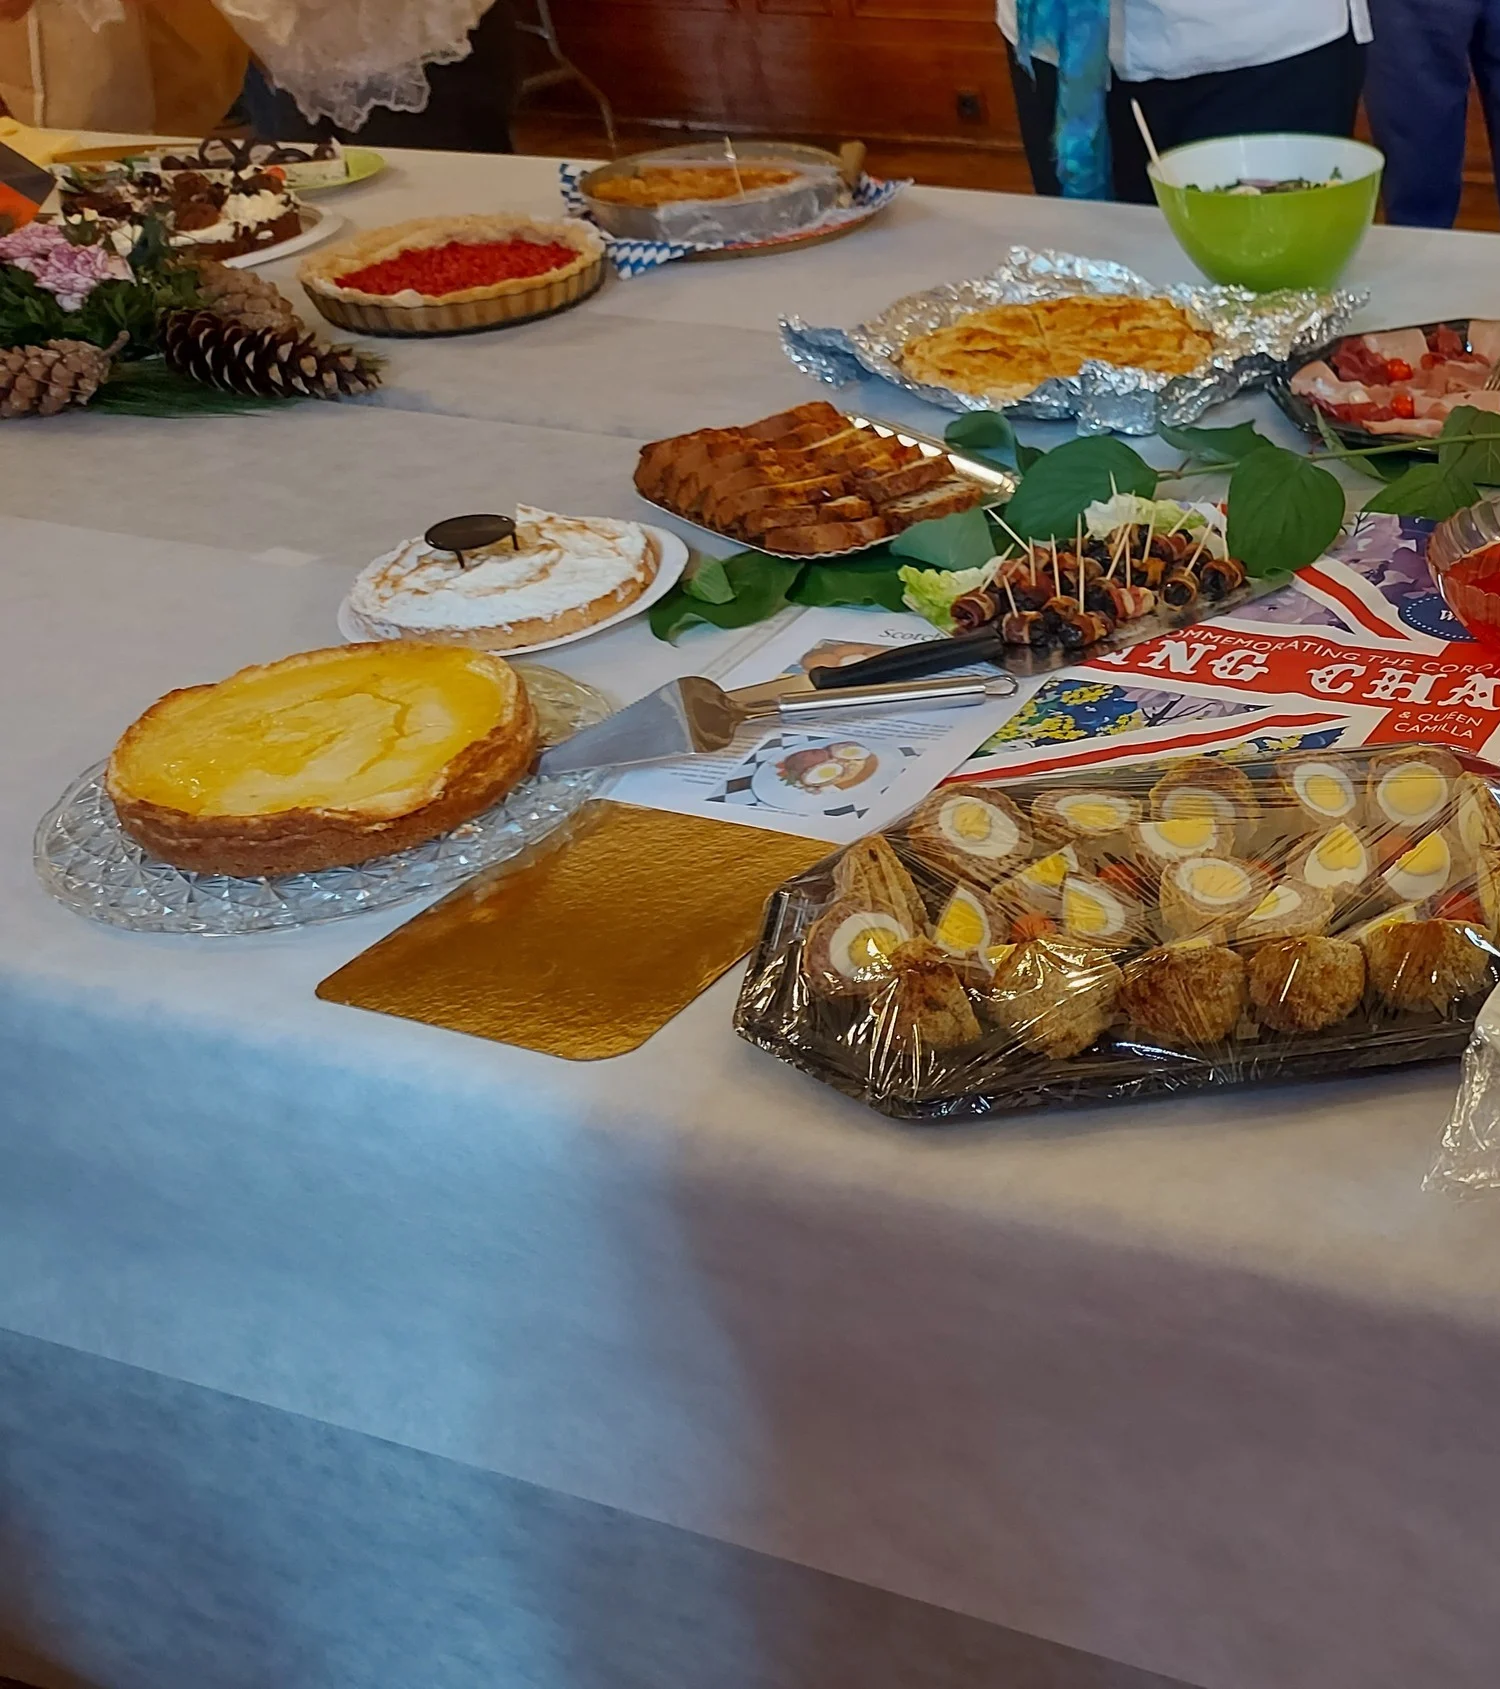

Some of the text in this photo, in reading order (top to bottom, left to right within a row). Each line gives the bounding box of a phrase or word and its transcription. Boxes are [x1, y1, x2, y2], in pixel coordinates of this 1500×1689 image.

[1096, 640, 1270, 682] ING
[1165, 629, 1361, 662] OMMEMORATING
[1368, 654, 1415, 667] THE
[1393, 722, 1473, 739] CAMILLA
[1398, 711, 1483, 726] & QUEEN
